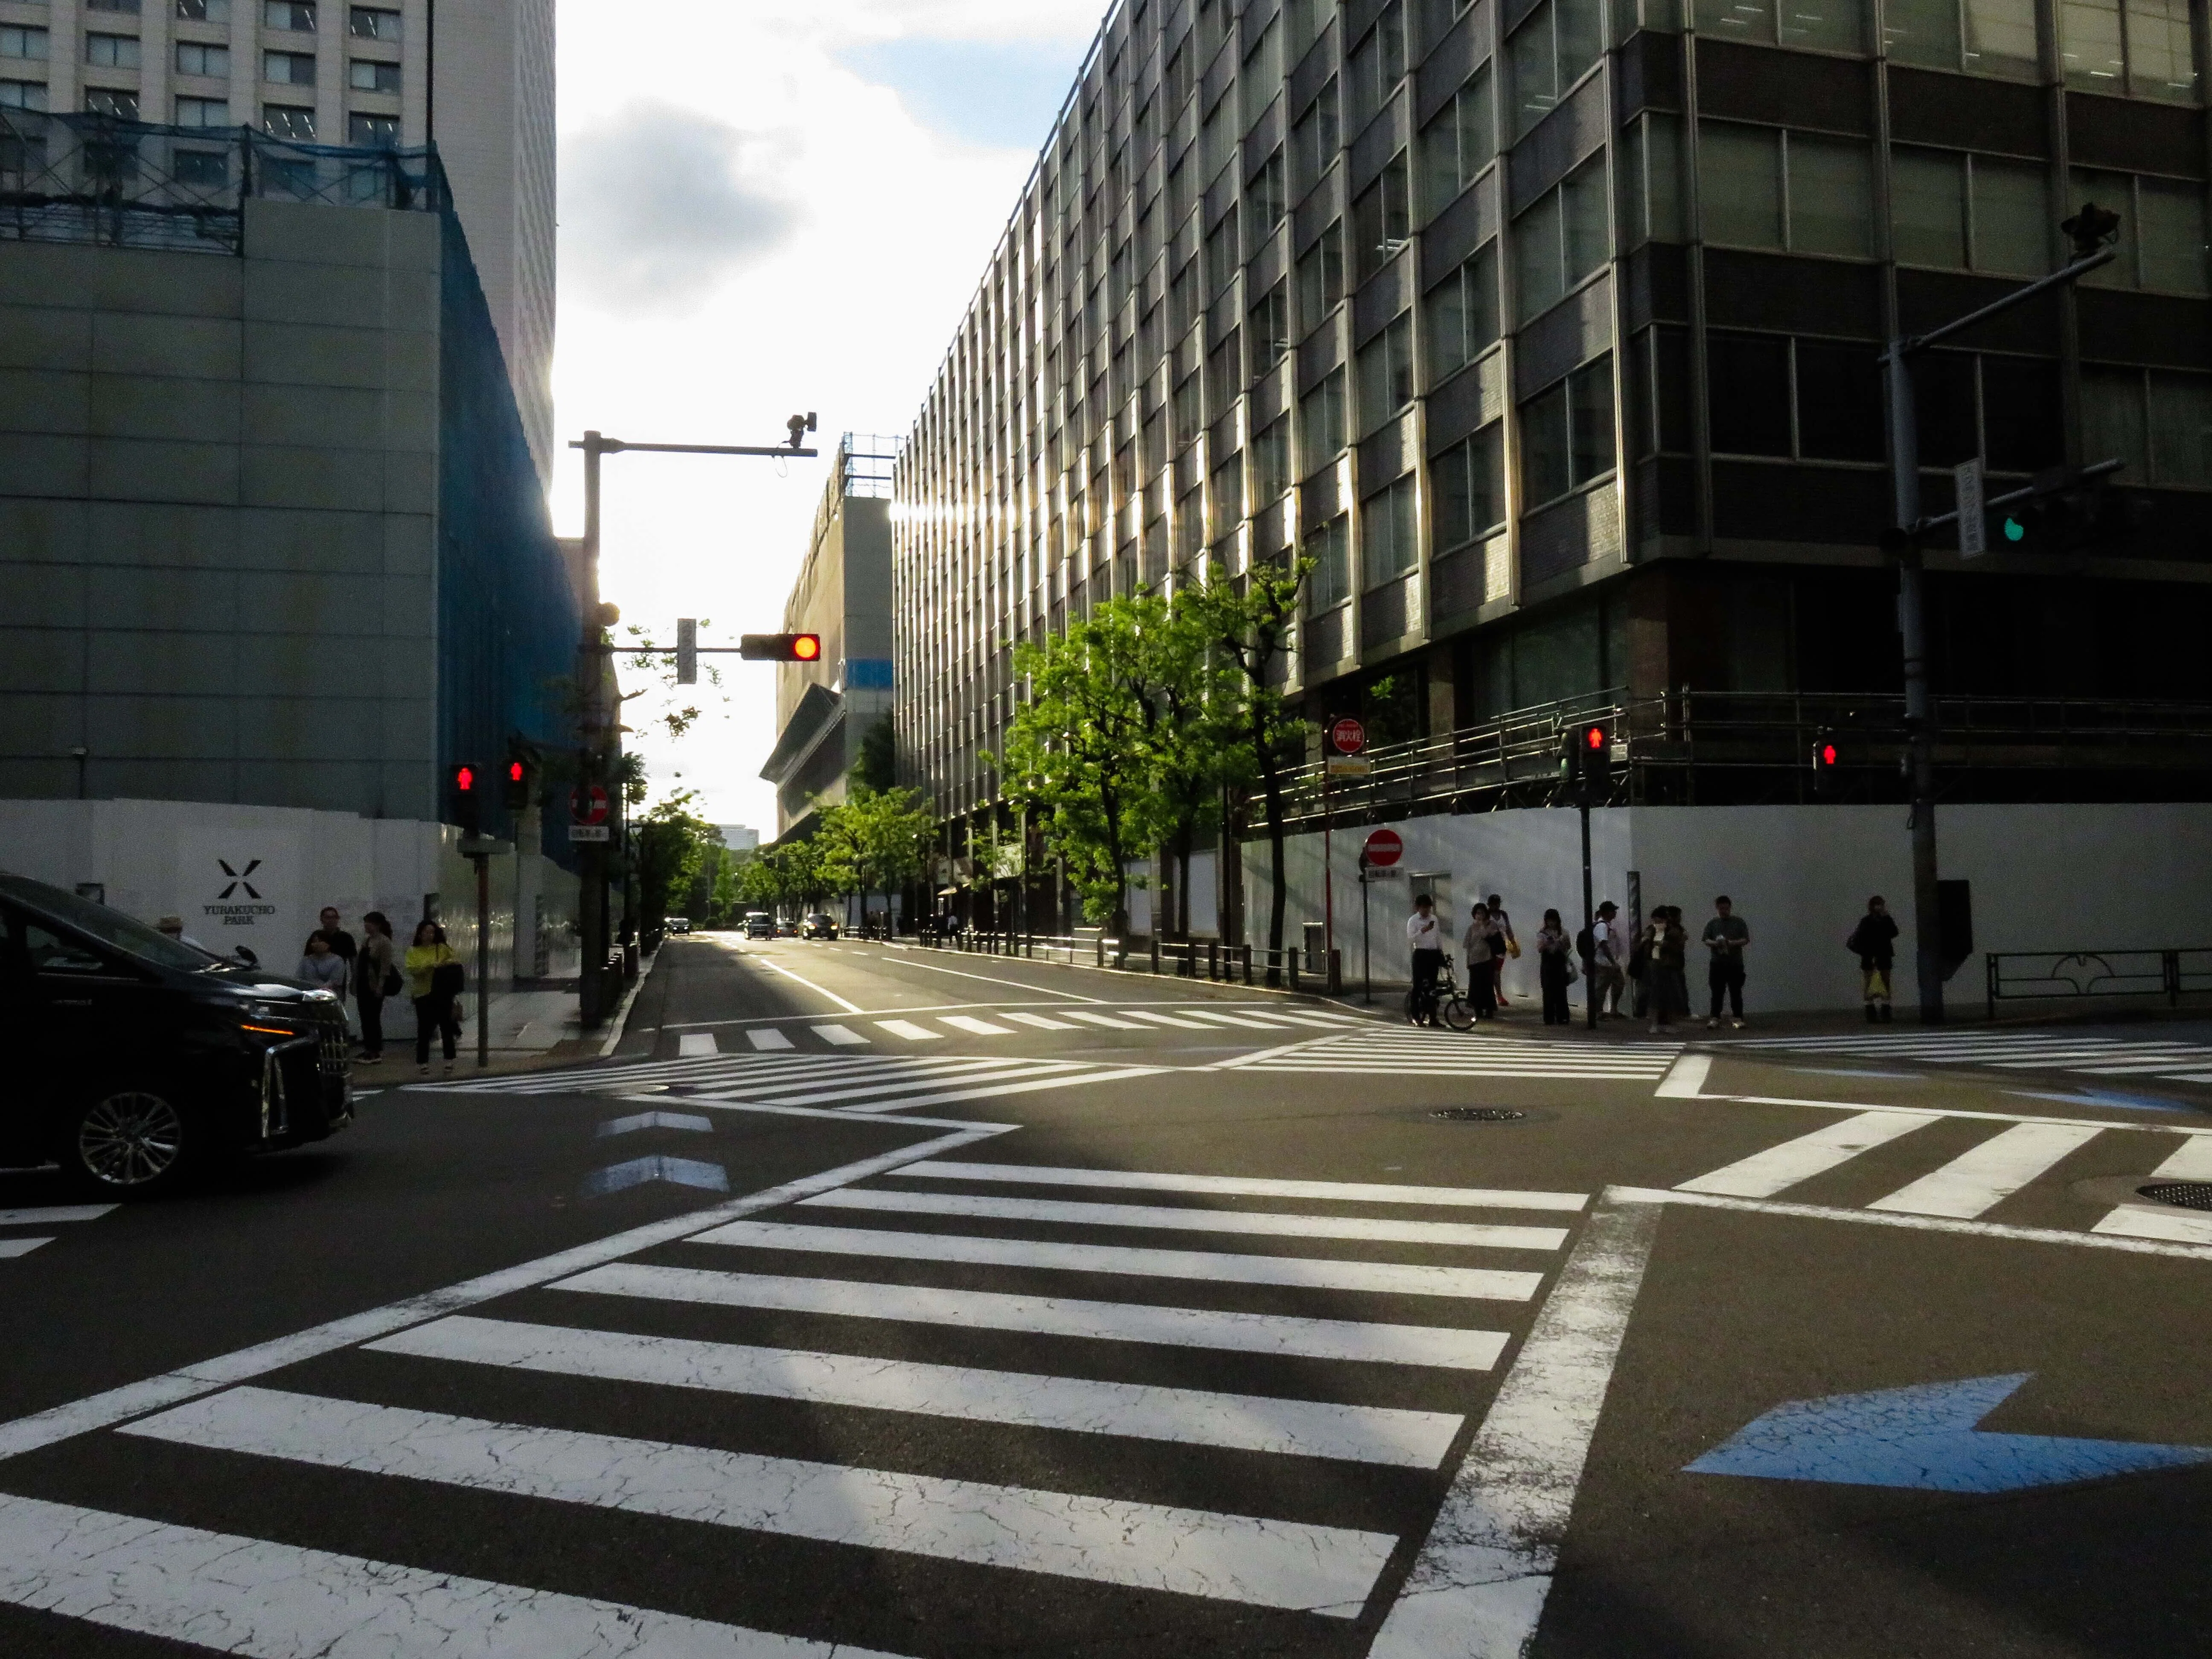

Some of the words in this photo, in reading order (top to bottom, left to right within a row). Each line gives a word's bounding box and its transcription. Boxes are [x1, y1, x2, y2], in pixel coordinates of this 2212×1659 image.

[1336, 730, 1361, 742] 消火栓
[204, 905, 275, 914] YURAKUCHO
[223, 916, 254, 925] PARK
